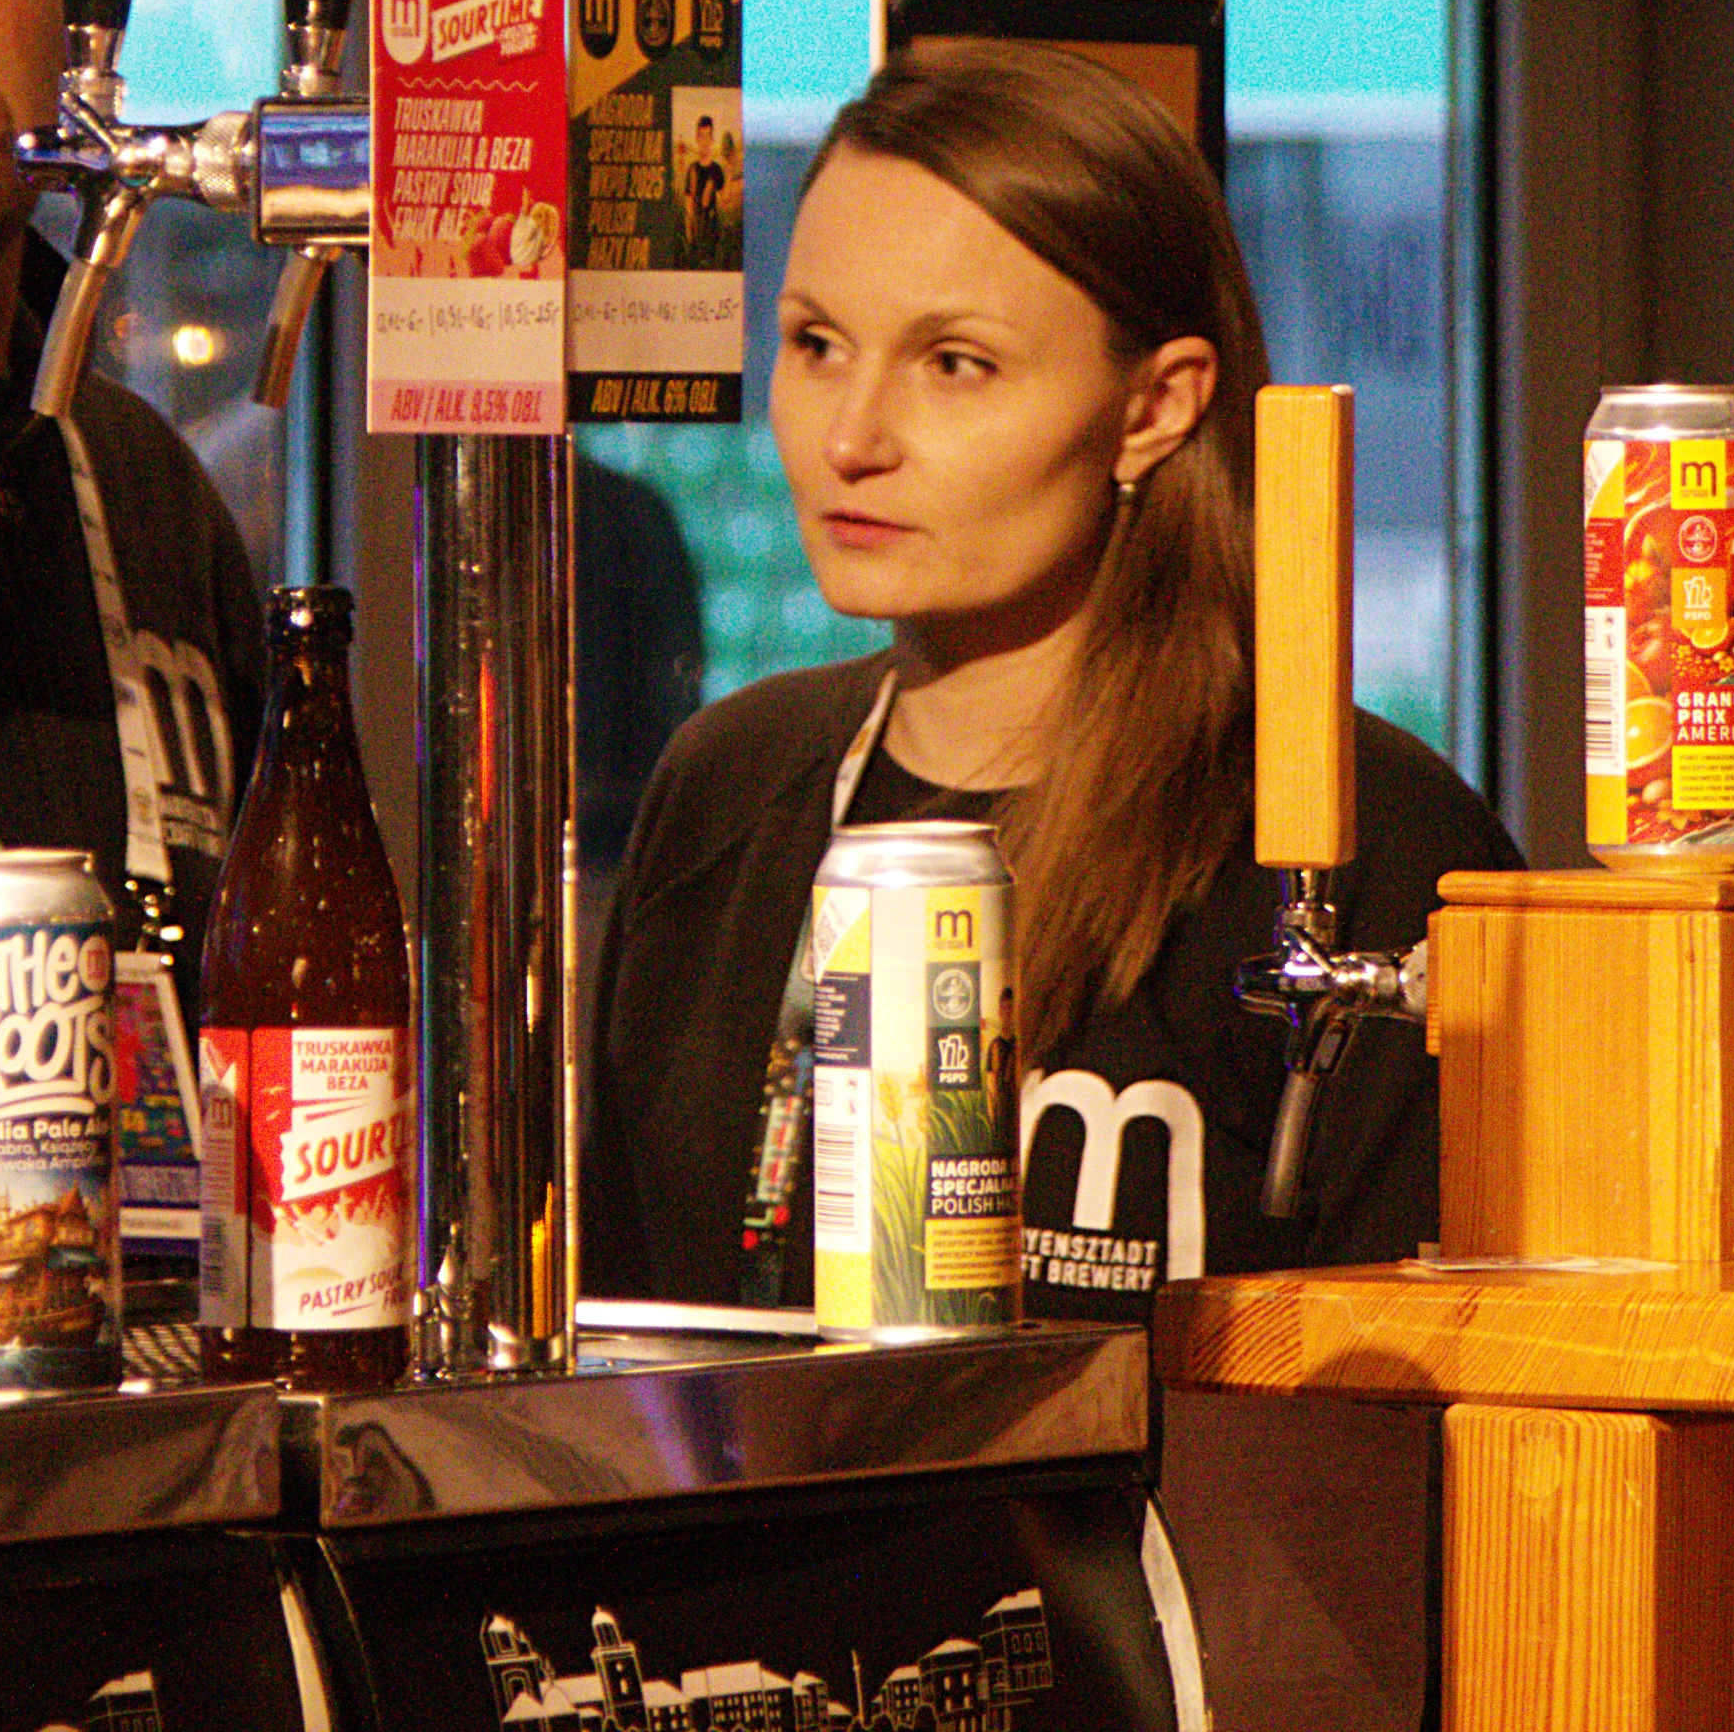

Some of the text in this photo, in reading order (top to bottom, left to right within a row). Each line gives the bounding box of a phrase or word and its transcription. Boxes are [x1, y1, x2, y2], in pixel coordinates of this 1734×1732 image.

[474, 135, 488, 169] &
[489, 136, 533, 171] BEZA
[392, 171, 496, 206] PASTRY SOUR
[390, 387, 426, 424] ABV
[590, 378, 623, 413] ABV
[1677, 709, 1727, 725] PRIX
[295, 1040, 393, 1059] TRUSKAWKA
[300, 1058, 390, 1076] MARAKUJA
[326, 1074, 369, 1092] BEZA
[33, 1116, 83, 1140] Pale
[294, 1108, 414, 1185] SOURT
[930, 1159, 1009, 1178] NAGRODA
[930, 1196, 995, 1216] POLISH
[1046, 1257, 1155, 1291] BREWERY
[299, 1277, 367, 1315] PASTRY
